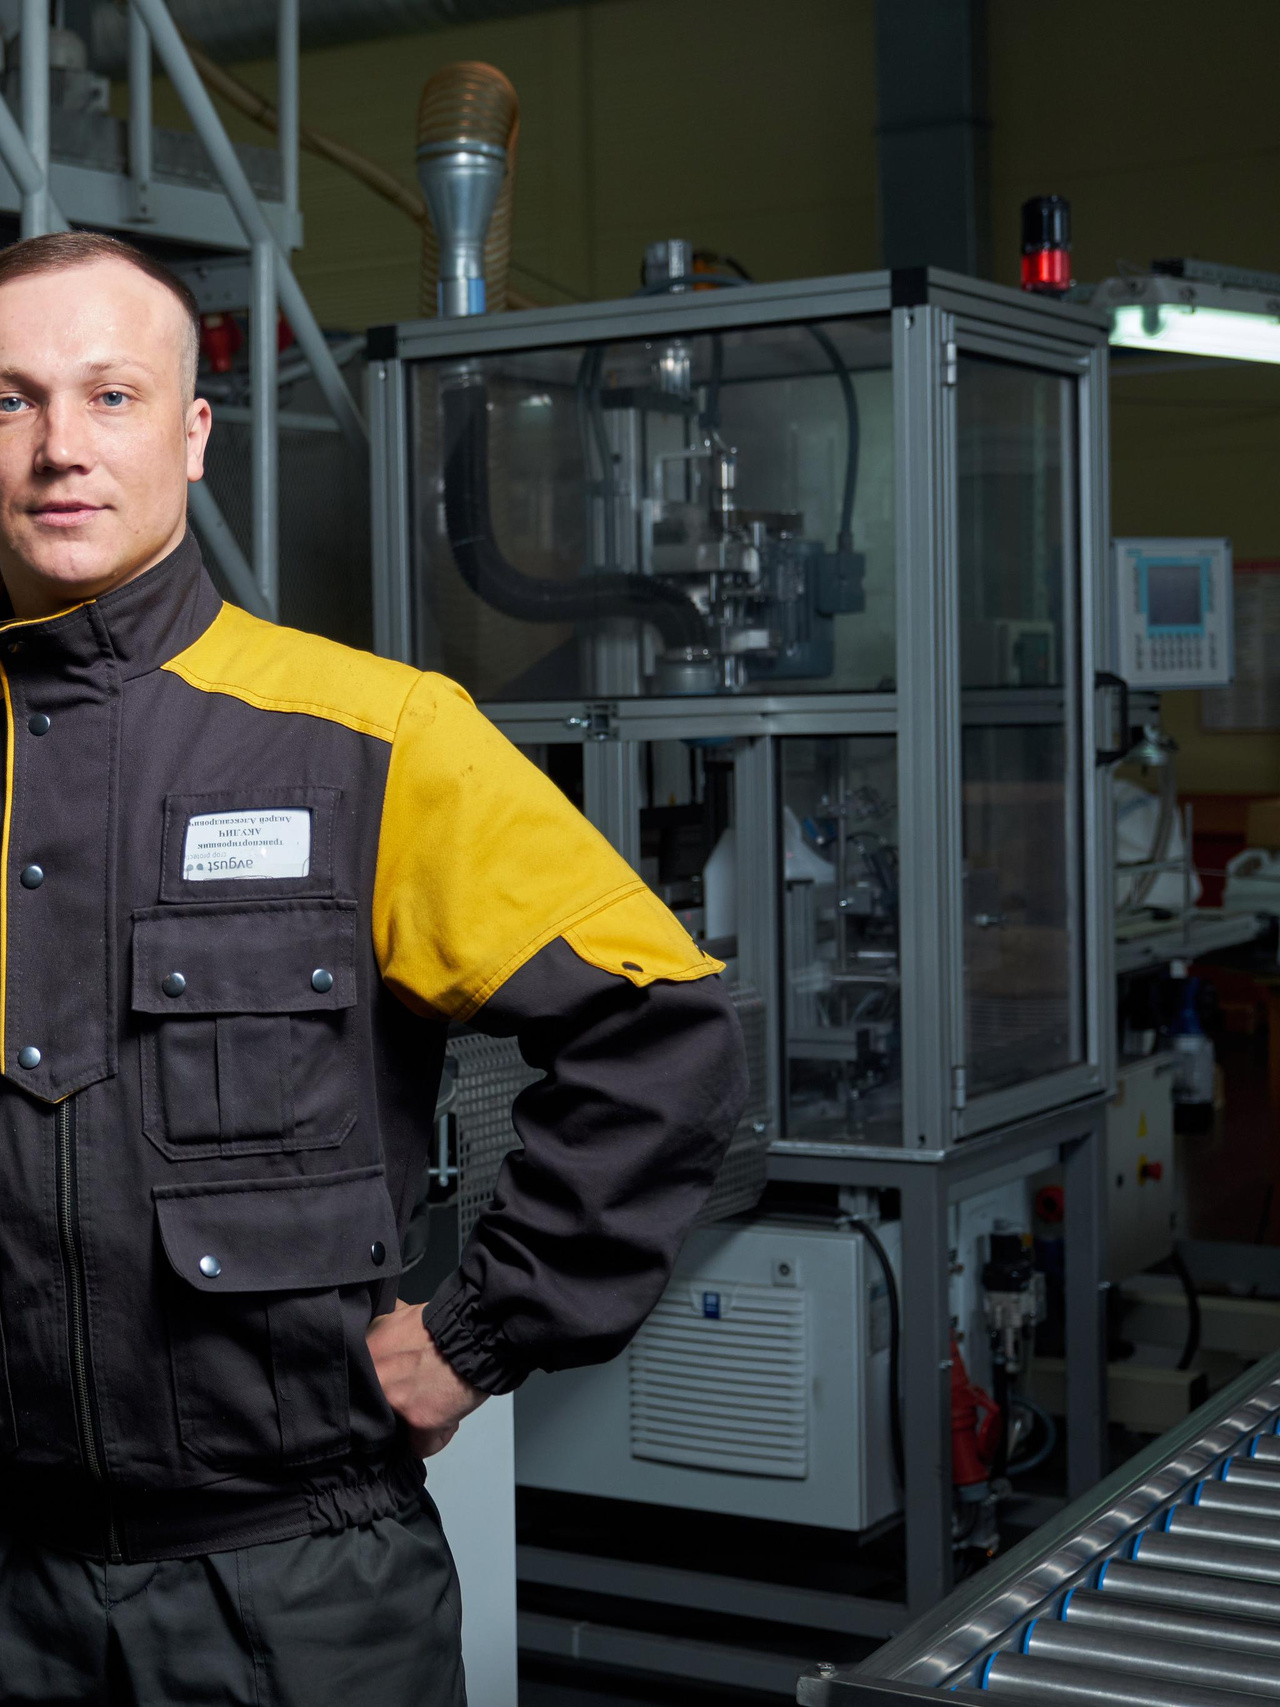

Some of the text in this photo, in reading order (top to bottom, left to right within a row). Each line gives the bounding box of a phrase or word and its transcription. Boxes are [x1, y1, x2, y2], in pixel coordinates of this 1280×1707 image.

[259, 815, 292, 824] Андрей
[218, 827, 261, 838] АКУЛИЧ
[197, 838, 283, 850] транспортировщик
[207, 857, 253, 873] avgust
